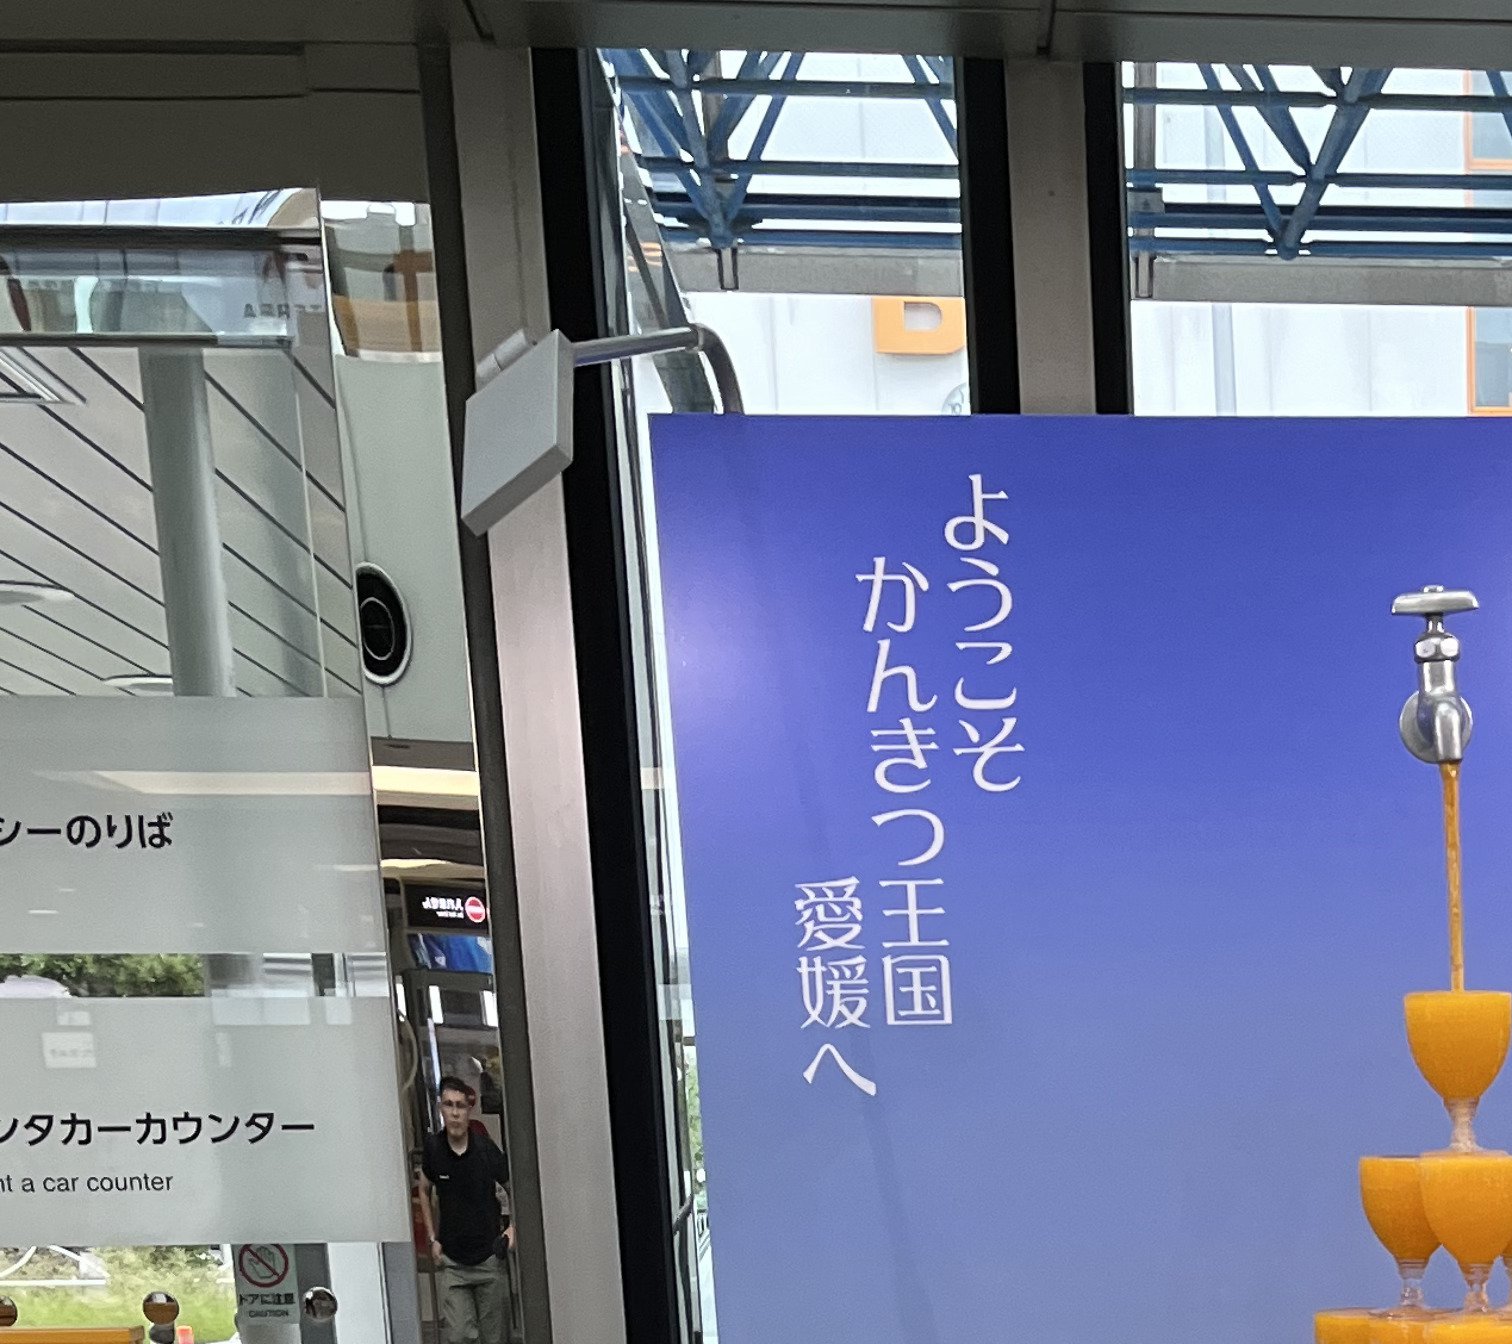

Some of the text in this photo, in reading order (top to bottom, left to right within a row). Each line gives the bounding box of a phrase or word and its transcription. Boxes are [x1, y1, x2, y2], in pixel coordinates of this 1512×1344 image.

[944, 474, 1025, 792] ようこそ
[855, 556, 952, 1026] かんきつ王国
[794, 875, 877, 1097] 愛媛へ
[21, 1177, 35, 1193] a
[43, 1176, 79, 1193] car
[87, 1173, 174, 1193] counter
